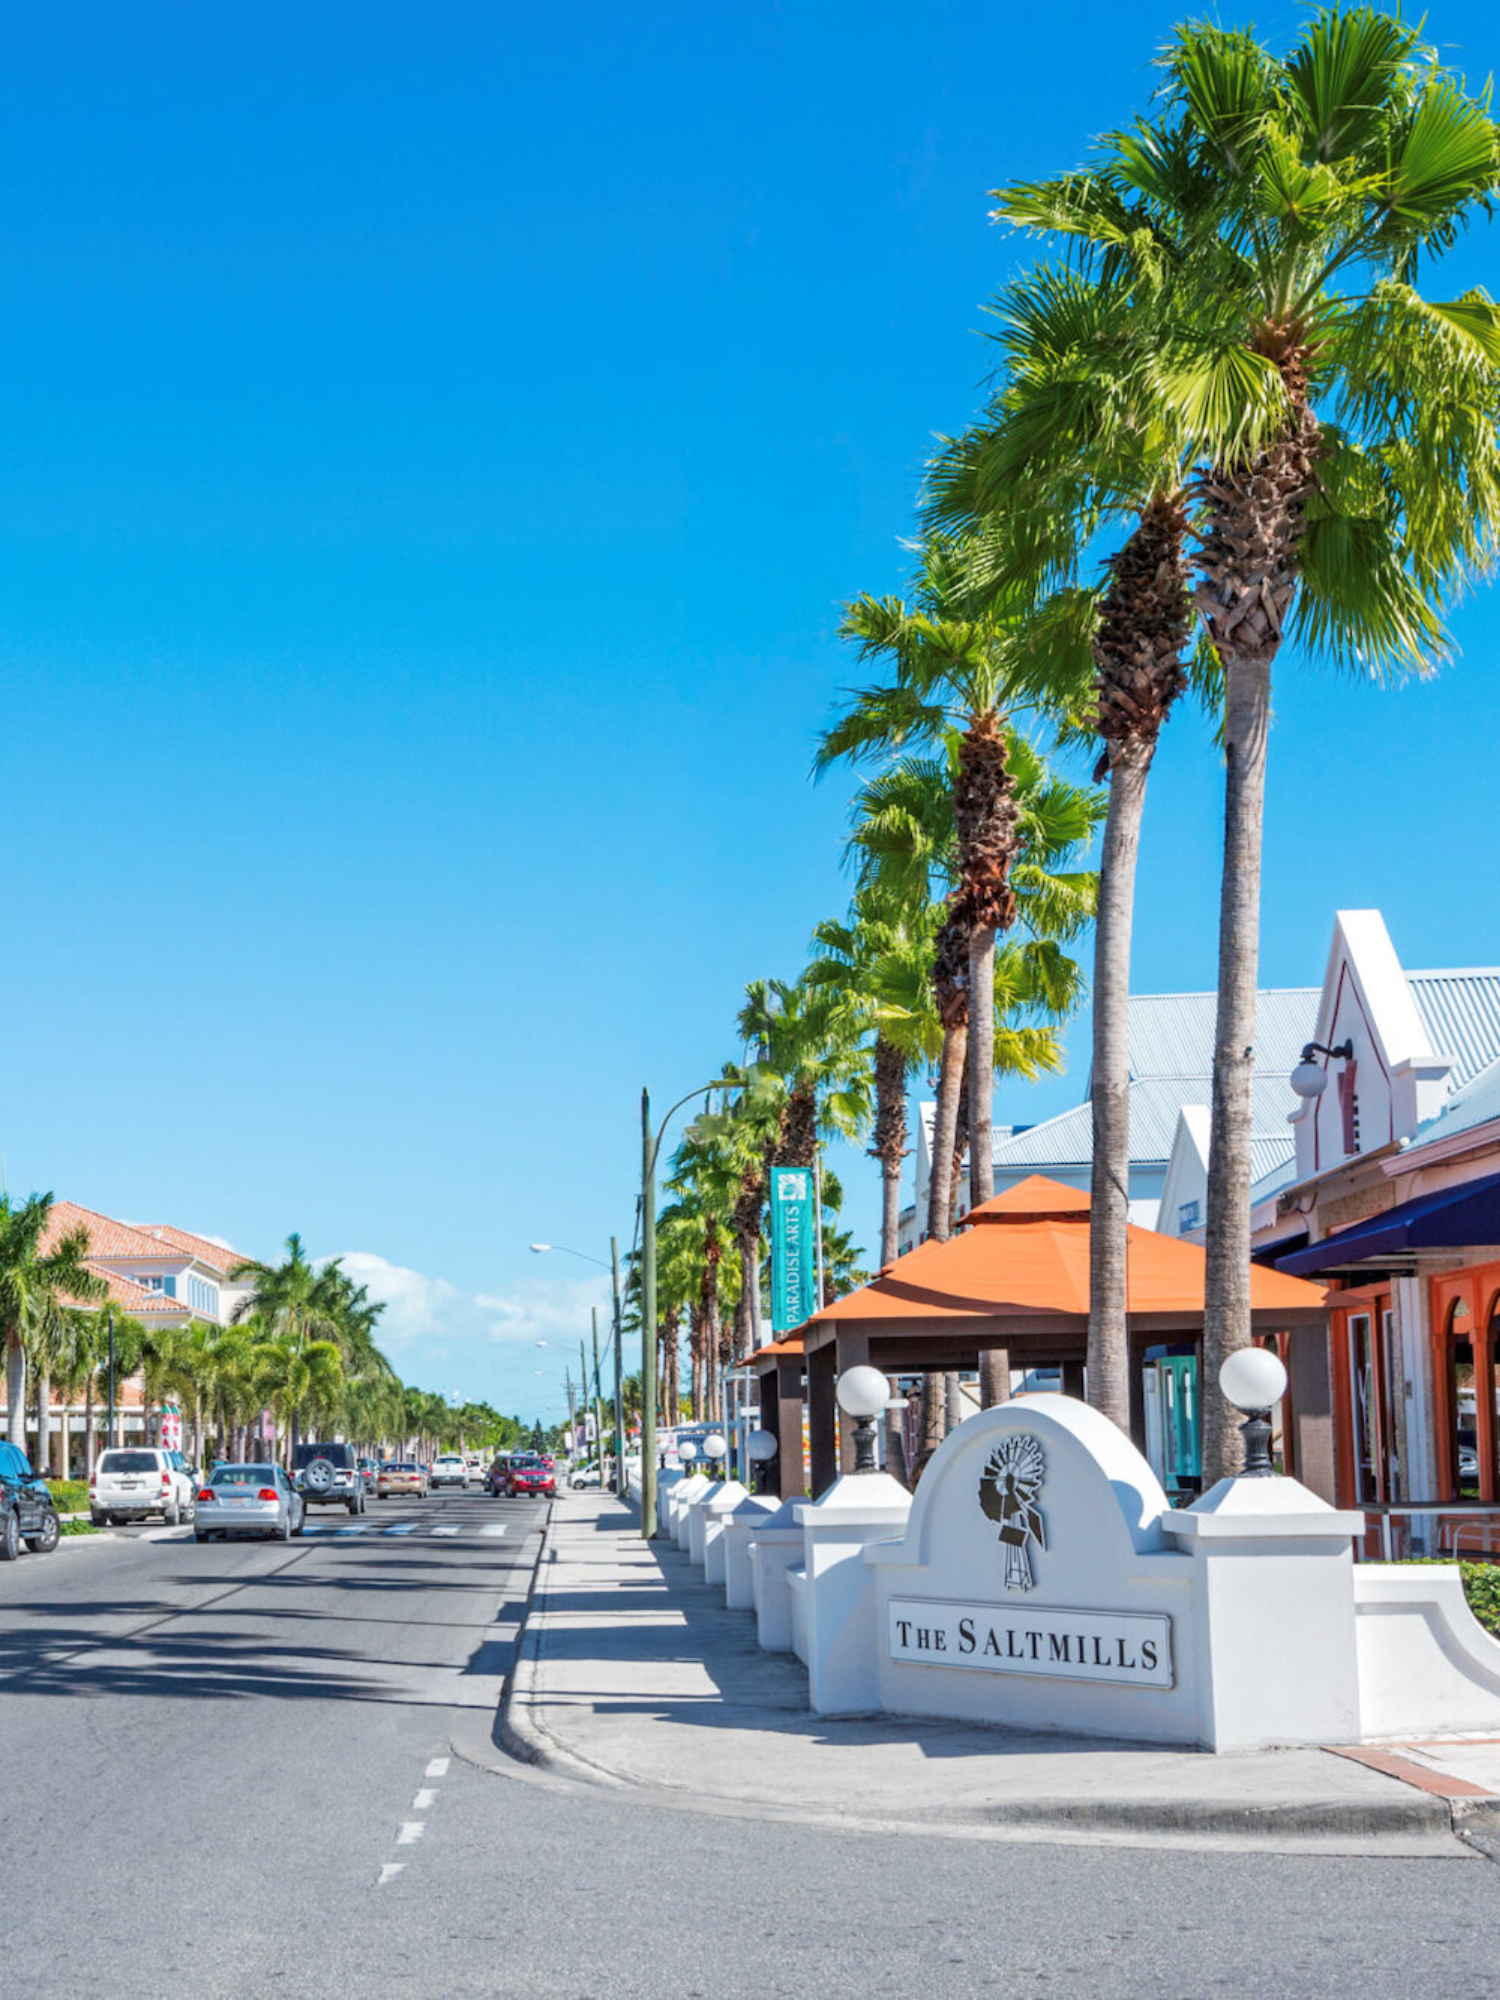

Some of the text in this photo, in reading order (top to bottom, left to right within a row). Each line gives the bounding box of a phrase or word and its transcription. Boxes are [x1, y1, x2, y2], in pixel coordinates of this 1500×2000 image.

[785, 1205, 800, 1323] PARADISE ARTS
[896, 1620, 948, 1651] THE
